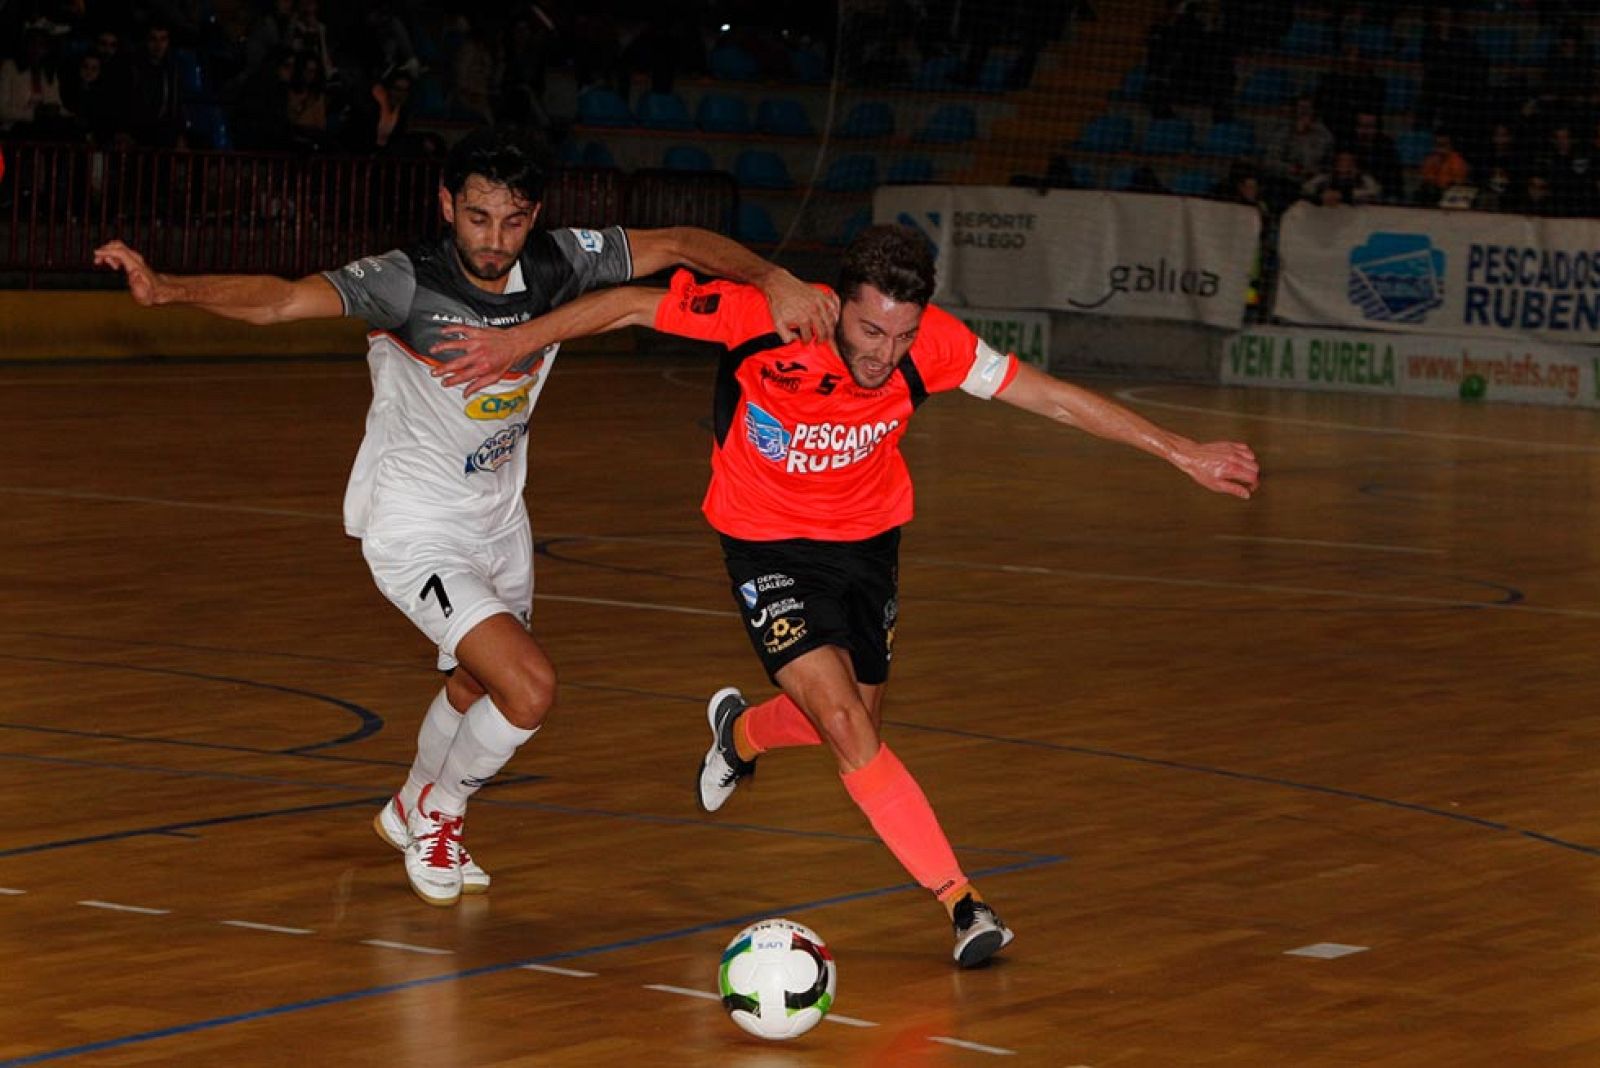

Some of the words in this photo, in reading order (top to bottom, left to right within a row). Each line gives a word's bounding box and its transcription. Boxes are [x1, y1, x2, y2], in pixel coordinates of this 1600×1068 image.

[953, 210, 1037, 230] DEPORTE
[952, 230, 1026, 249] GALEGO
[1467, 243, 1600, 290] PESCADOS
[1231, 335, 1274, 377] VEN
[1277, 338, 1295, 378] A
[1307, 338, 1396, 387] BURELA
[816, 372, 842, 395] 5
